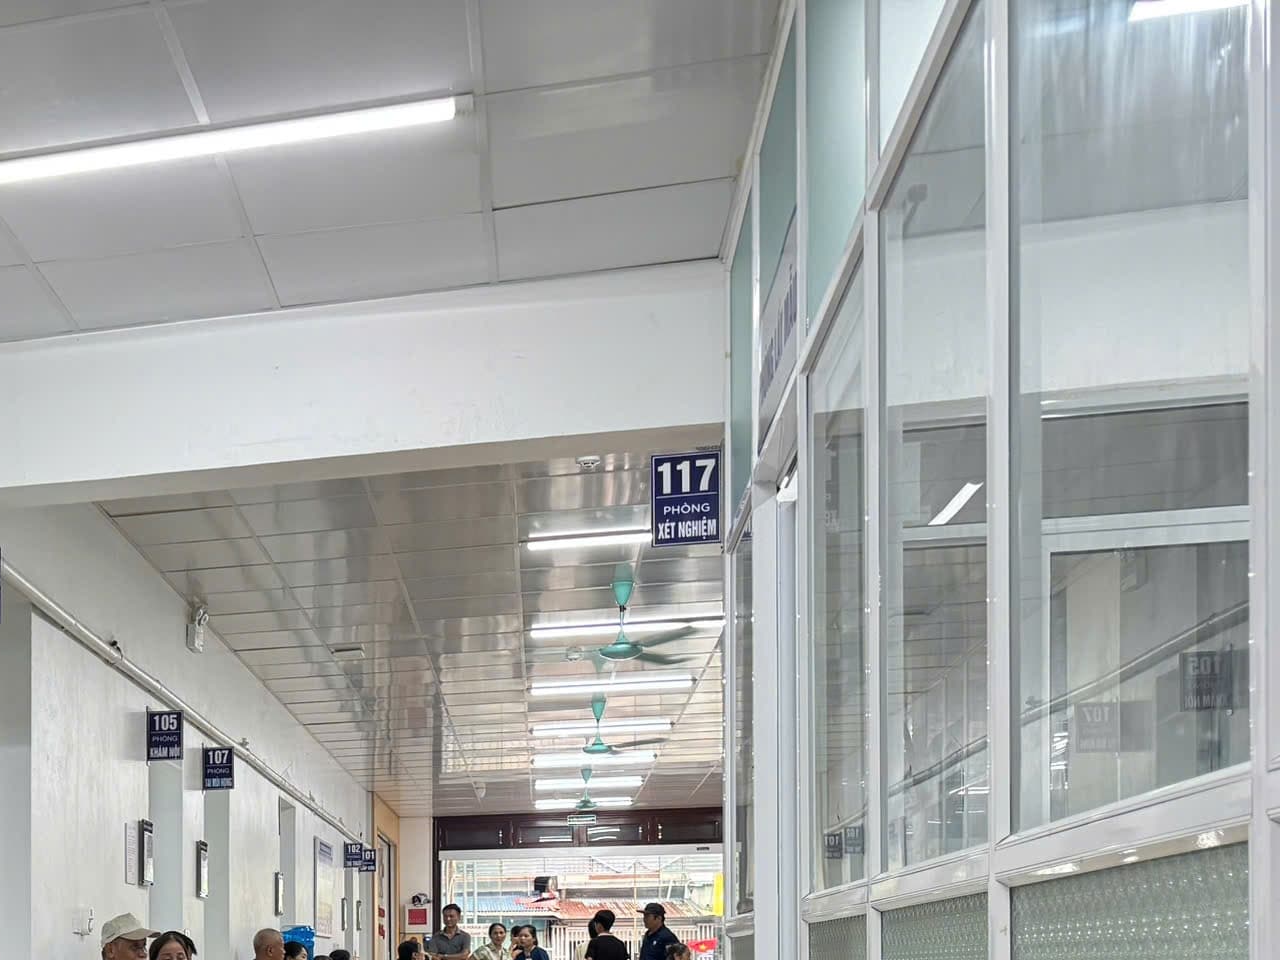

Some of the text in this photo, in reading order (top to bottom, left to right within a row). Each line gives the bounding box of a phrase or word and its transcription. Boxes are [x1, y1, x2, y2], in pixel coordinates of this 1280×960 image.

[657, 459, 716, 495] 117
[663, 502, 711, 515] PHÒNG
[658, 516, 717, 540] XÉT NGHIỆM
[153, 714, 177, 731] 105
[150, 744, 168, 758] KHÁM
[207, 750, 229, 764] 107
[348, 844, 361, 853] 102
[363, 850, 375, 860] 101
